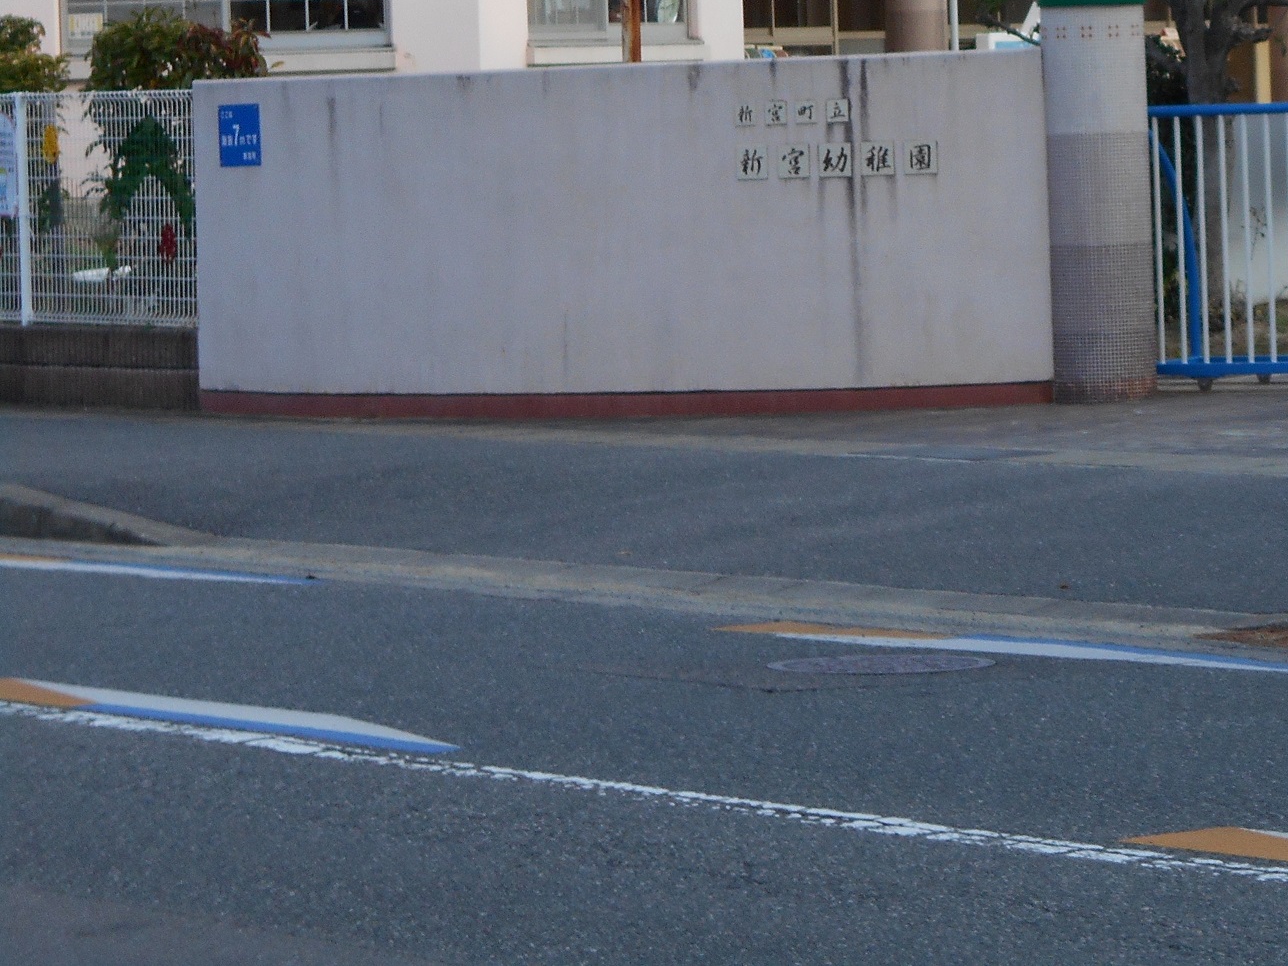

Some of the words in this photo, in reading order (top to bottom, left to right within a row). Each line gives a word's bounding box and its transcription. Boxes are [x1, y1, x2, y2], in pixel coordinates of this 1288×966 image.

[738, 102, 846, 123] 新宮町立
[740, 144, 932, 176] 新宮幼稚園
